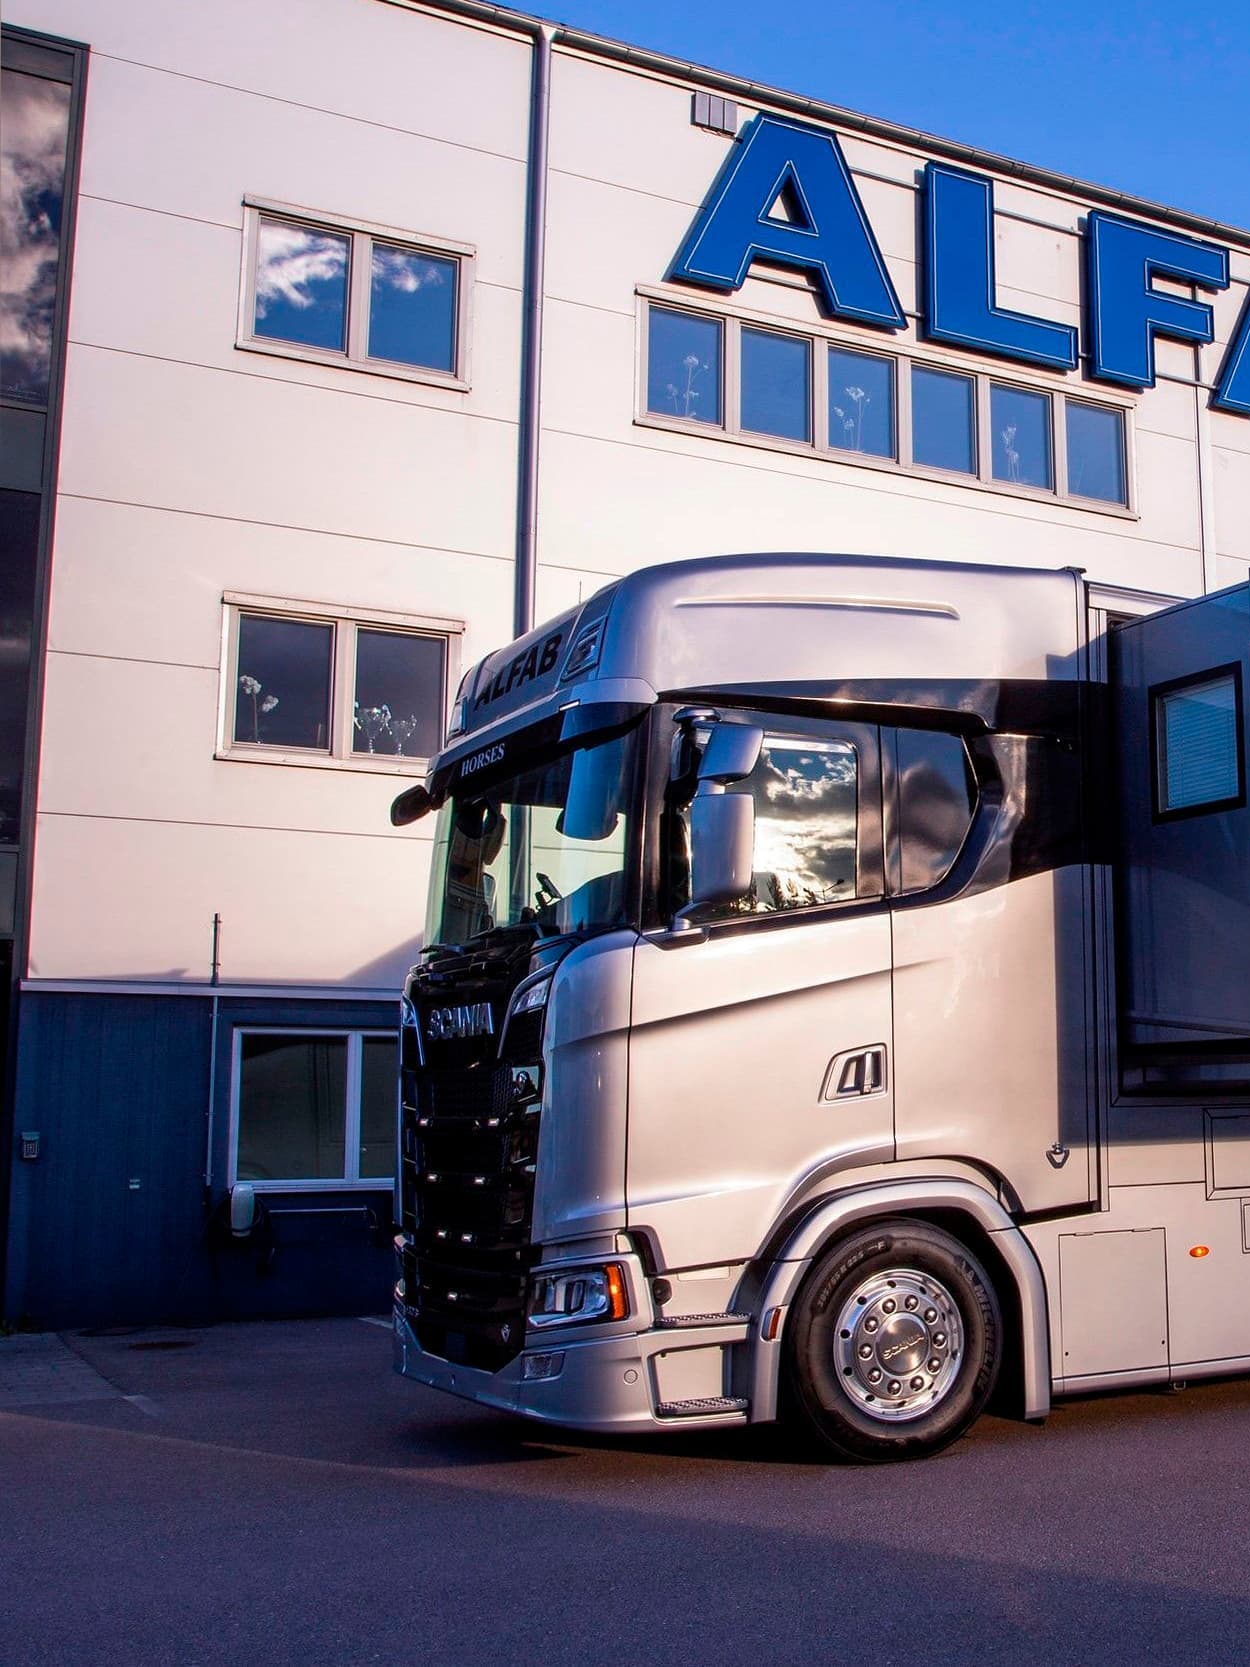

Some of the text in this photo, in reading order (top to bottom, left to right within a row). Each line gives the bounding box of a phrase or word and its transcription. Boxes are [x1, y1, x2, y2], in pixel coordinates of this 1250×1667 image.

[474, 633, 562, 712] ALFAB
[461, 743, 505, 777] HORSES
[427, 1003, 494, 1040] SCANIA
[882, 1333, 925, 1361] SCANIA
